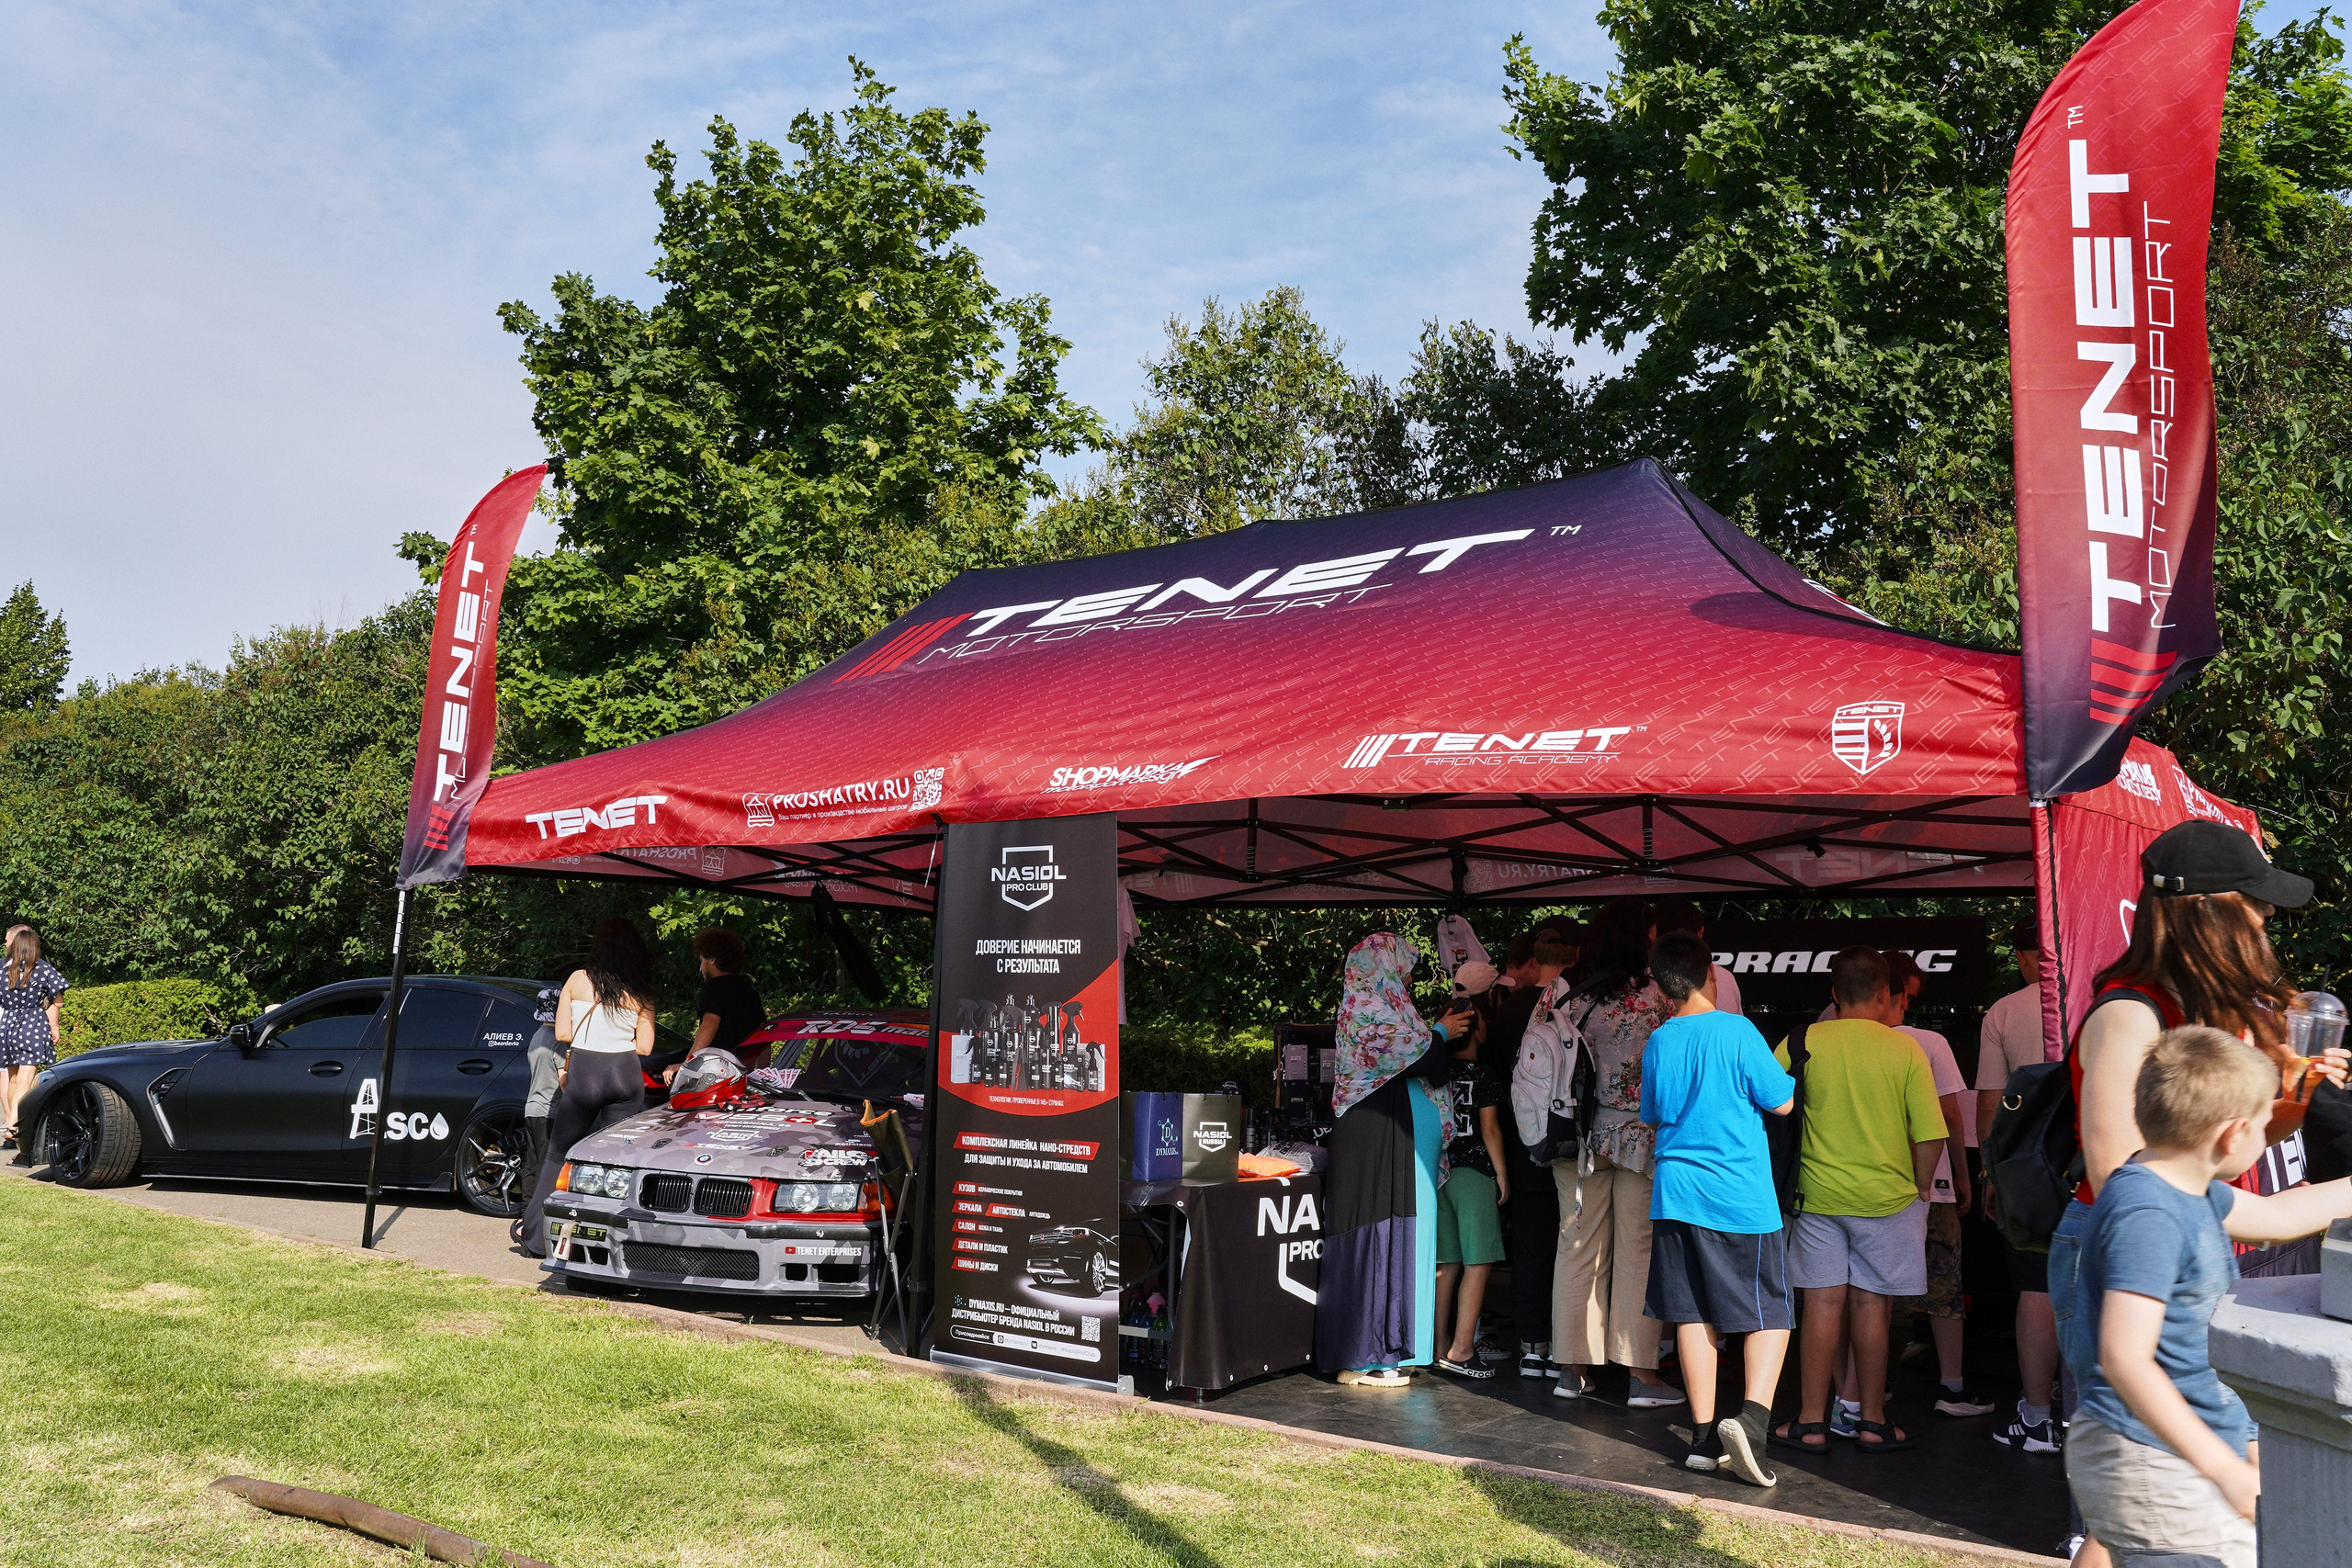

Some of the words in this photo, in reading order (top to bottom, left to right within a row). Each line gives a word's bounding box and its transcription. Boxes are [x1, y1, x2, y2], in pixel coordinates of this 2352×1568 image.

[2068, 139, 2143, 633] TENET
[2143, 201, 2177, 628] MOTORSPORT
[967, 528, 1535, 637] TENET
[918, 583, 1392, 665] MOTORSPORT
[434, 541, 484, 802] TENET
[1838, 705, 1902, 716] TENET
[1396, 727, 1631, 753] TENET
[1425, 755, 1502, 766] RACING
[1508, 755, 1618, 765] ACADEMY
[1049, 761, 1184, 787] SHOPMARKA
[773, 777, 910, 810] PROSHATRY.RU
[526, 795, 669, 840] TENET
[856, 807, 887, 815] мобильных
[888, 804, 908, 812] шатров
[991, 865, 1067, 881] NASIOL
[1006, 883, 1024, 891] PRO
[1025, 883, 1048, 891] CLUB
[975, 940, 1020, 955] ДОВЕРИЕ
[1021, 939, 1080, 954] НАЧИНАЕТСЯ
[997, 959, 1003, 973] С
[1004, 958, 1059, 974] РЕЗУЛЬТАТА
[483, 1032, 514, 1041] АЛИЕВ
[962, 1135, 1008, 1148] КОМПЛЕКСНАЯ
[1009, 1139, 1037, 1151] ЛИНЕЙКА
[1193, 1131, 1232, 1139] NASIOL
[965, 1154, 978, 1164] ДЛЯ
[978, 1155, 1006, 1167] ЗАЩИТЫ
[1007, 1157, 1012, 1166] И
[1012, 1158, 1033, 1168] УХОДА
[1034, 1160, 1041, 1169] ЗА
[1042, 1161, 1088, 1174] АВТОМОБИЛЕМ
[958, 1183, 976, 1192] КУЗОВ
[958, 1202, 982, 1213] ЗЕРКАЛА
[992, 1205, 1025, 1217] АВТОСТЕКЛА
[958, 1222, 975, 1231] САЛОН
[797, 1247, 817, 1255] TENET
[819, 1247, 862, 1256] ENTERPRISES
[958, 1240, 978, 1250] ДЕТАЛИ
[978, 1242, 983, 1251] И
[984, 1243, 1008, 1254] ПЛАСТИК
[1289, 1239, 1325, 1262] PRO
[957, 1259, 974, 1269] ШИНЫ
[975, 1261, 978, 1269] И
[979, 1261, 998, 1272] ДИСКИ
[968, 1298, 1004, 1313] DYMAXIS.RU
[1011, 1304, 1059, 1321] ОФИЦИАЛЬНЫЙ
[952, 1308, 998, 1324] ДИСТРИБЬЮТЕР
[999, 1317, 1023, 1328] БРЕНДА
[1023, 1320, 1045, 1331] NASIOL
[1045, 1323, 1050, 1332] В
[1050, 1324, 1075, 1336] РОССИИ
[1467, 1370, 1494, 1378] crocs
